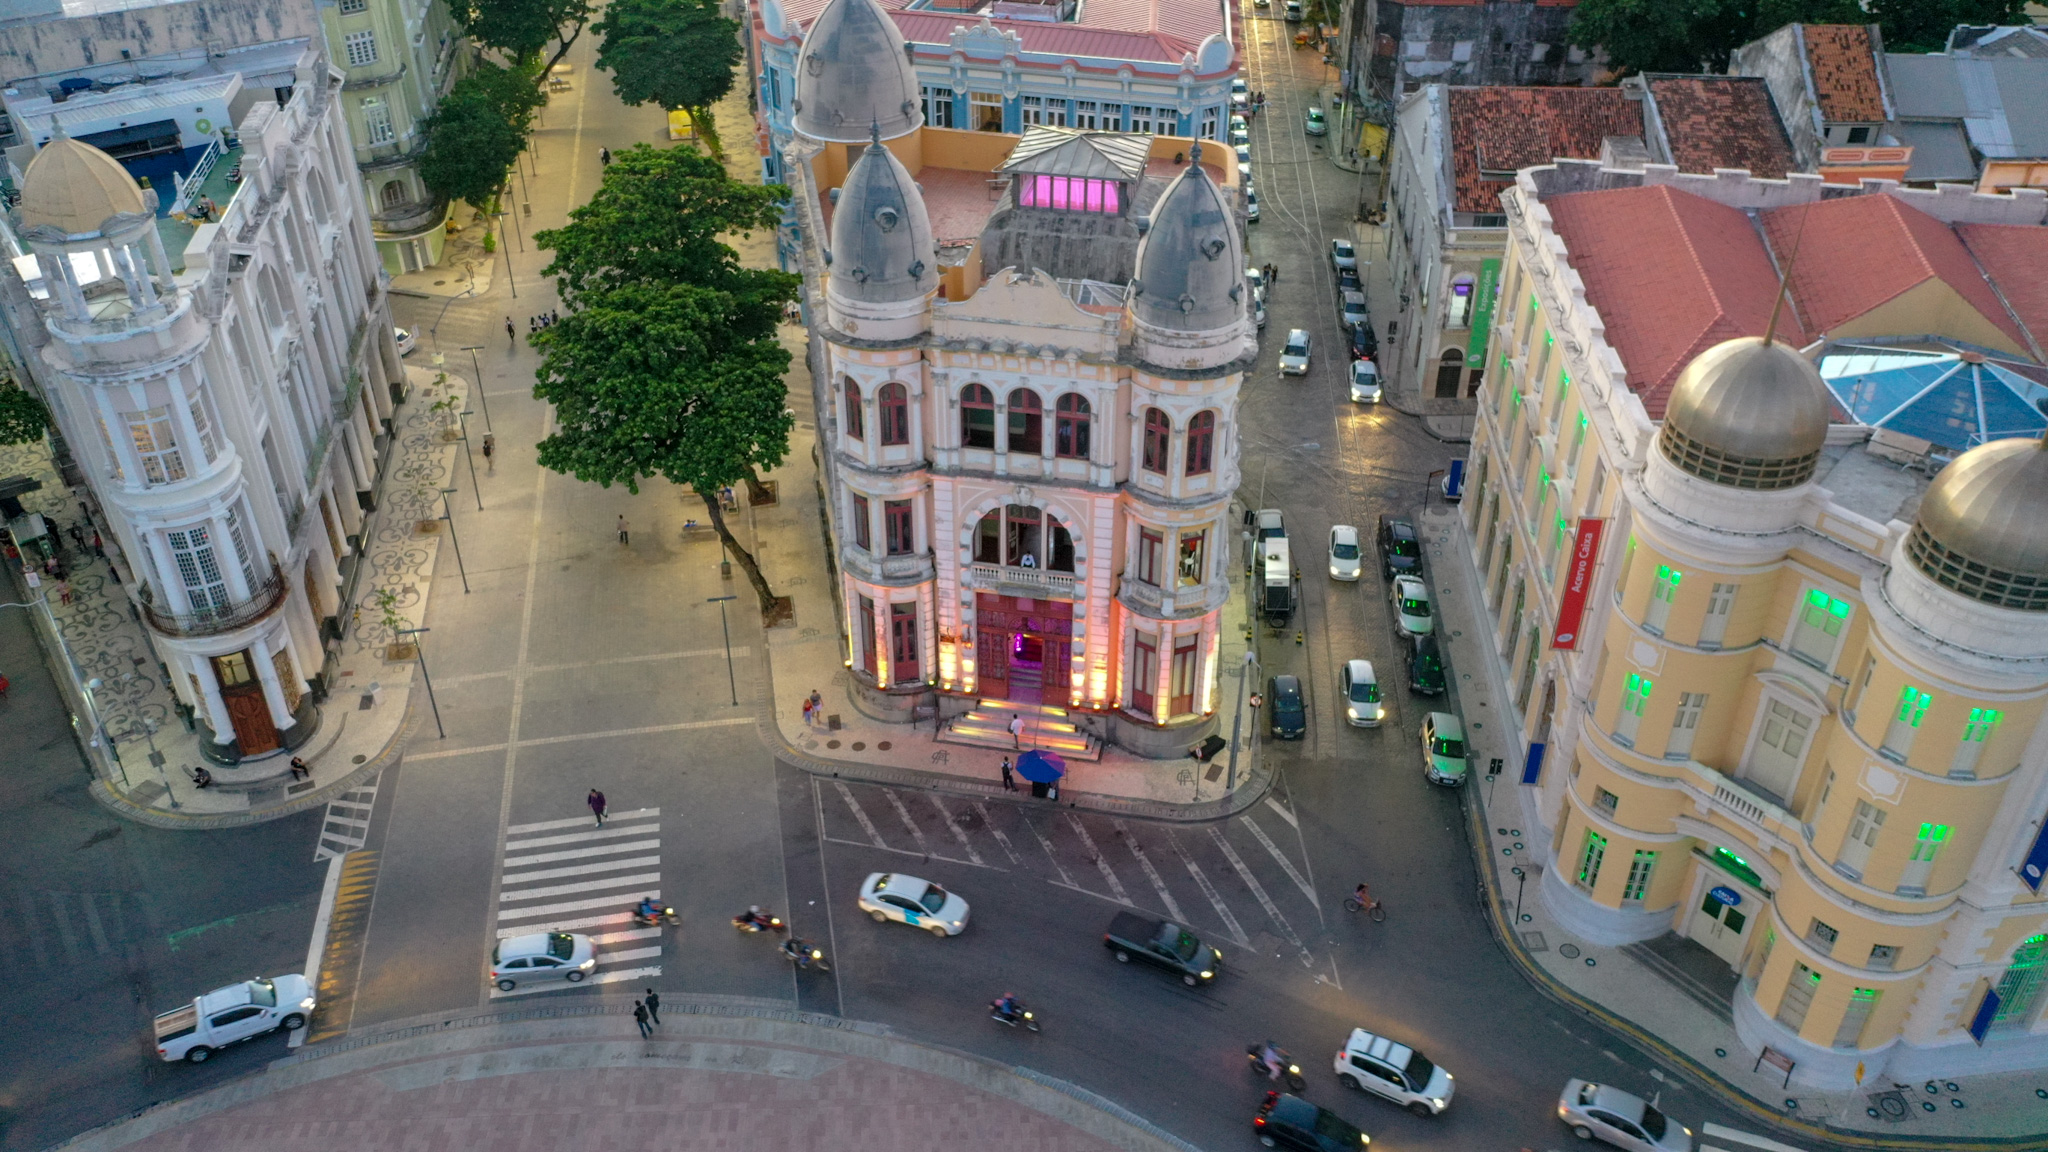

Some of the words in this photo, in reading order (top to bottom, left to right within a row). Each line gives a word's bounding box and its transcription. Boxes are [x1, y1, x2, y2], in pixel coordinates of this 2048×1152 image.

[1479, 270, 1493, 312] Exposições
[1571, 561, 1587, 593] Acervo
[1579, 532, 1593, 558] Caixa
